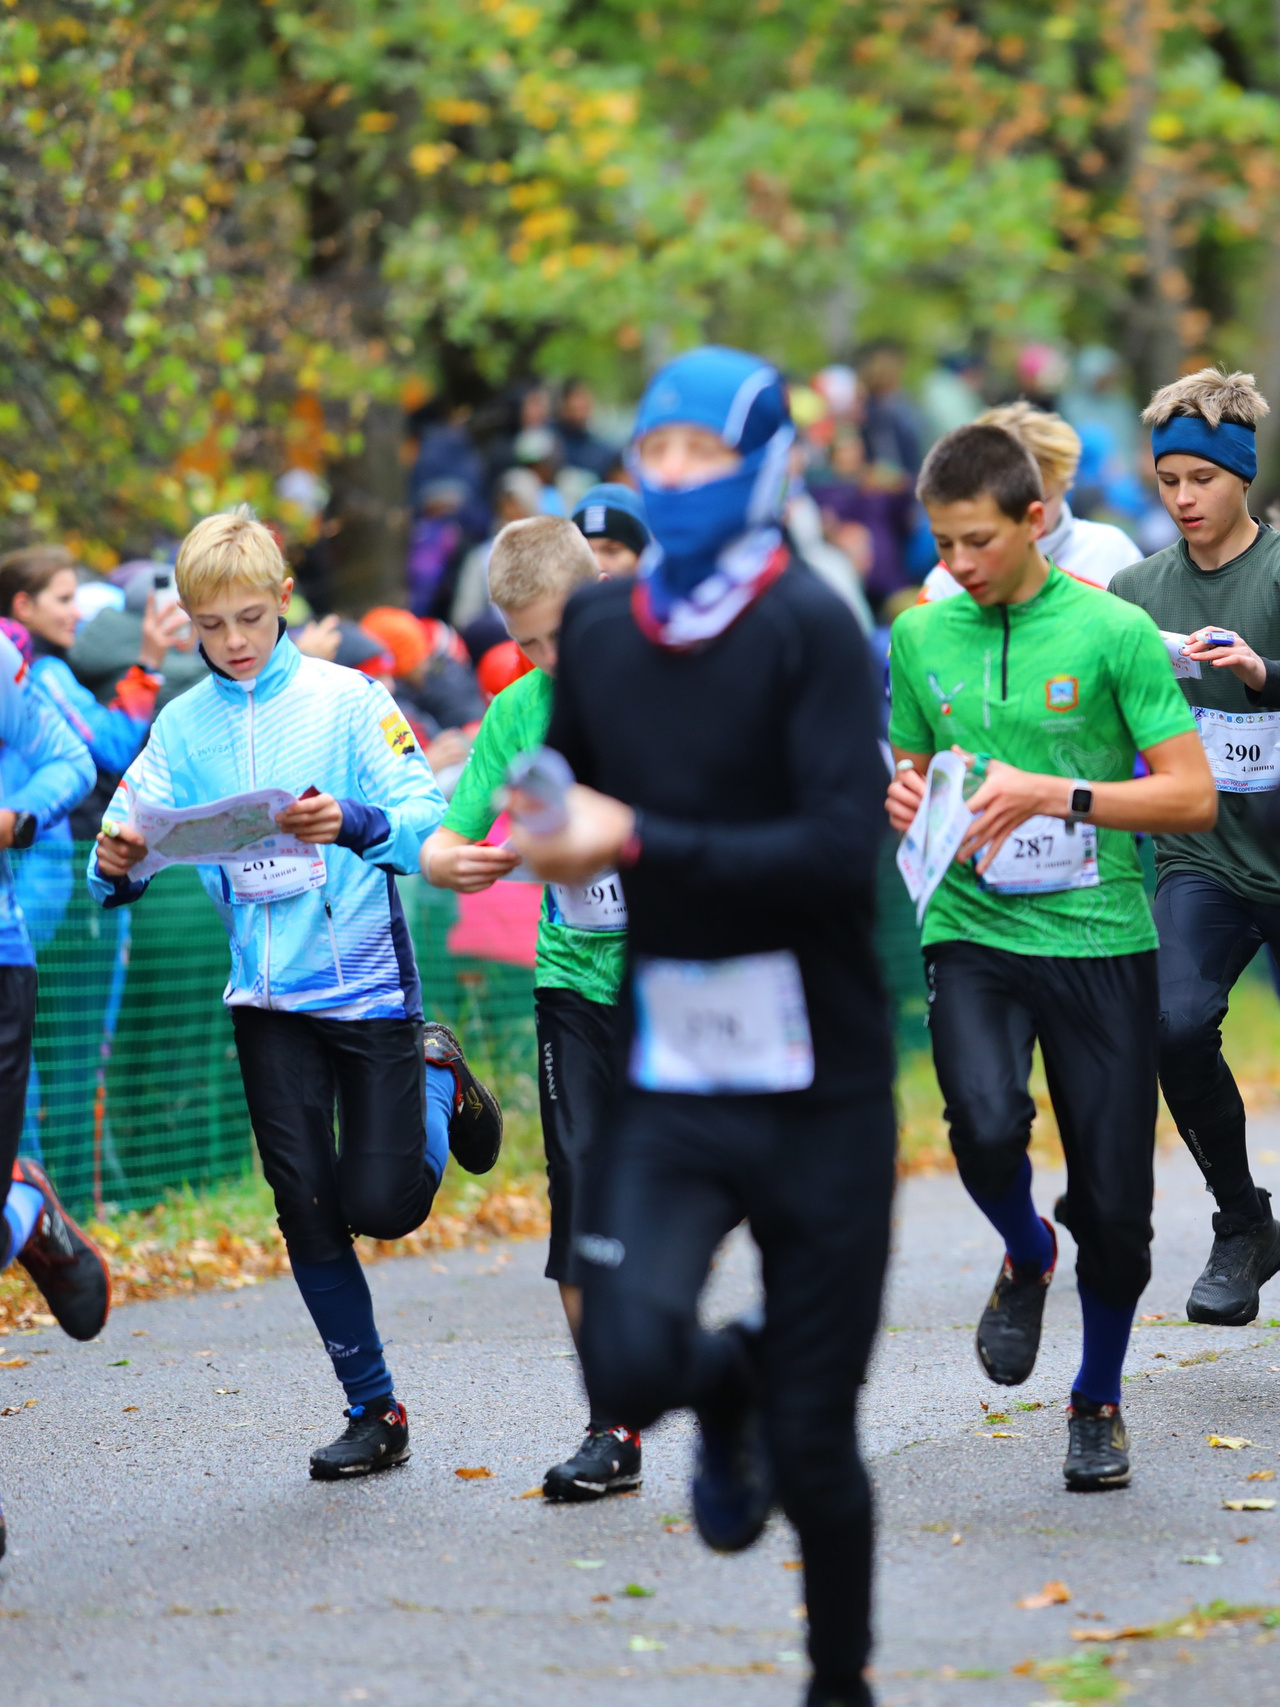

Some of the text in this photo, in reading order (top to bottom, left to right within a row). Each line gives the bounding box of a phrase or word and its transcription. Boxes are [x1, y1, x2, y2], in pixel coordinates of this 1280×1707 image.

[1224, 742, 1261, 763] 290
[1248, 765, 1275, 773] линия
[1015, 835, 1054, 858] 287
[269, 866, 297, 880] линия
[583, 883, 618, 905] 291
